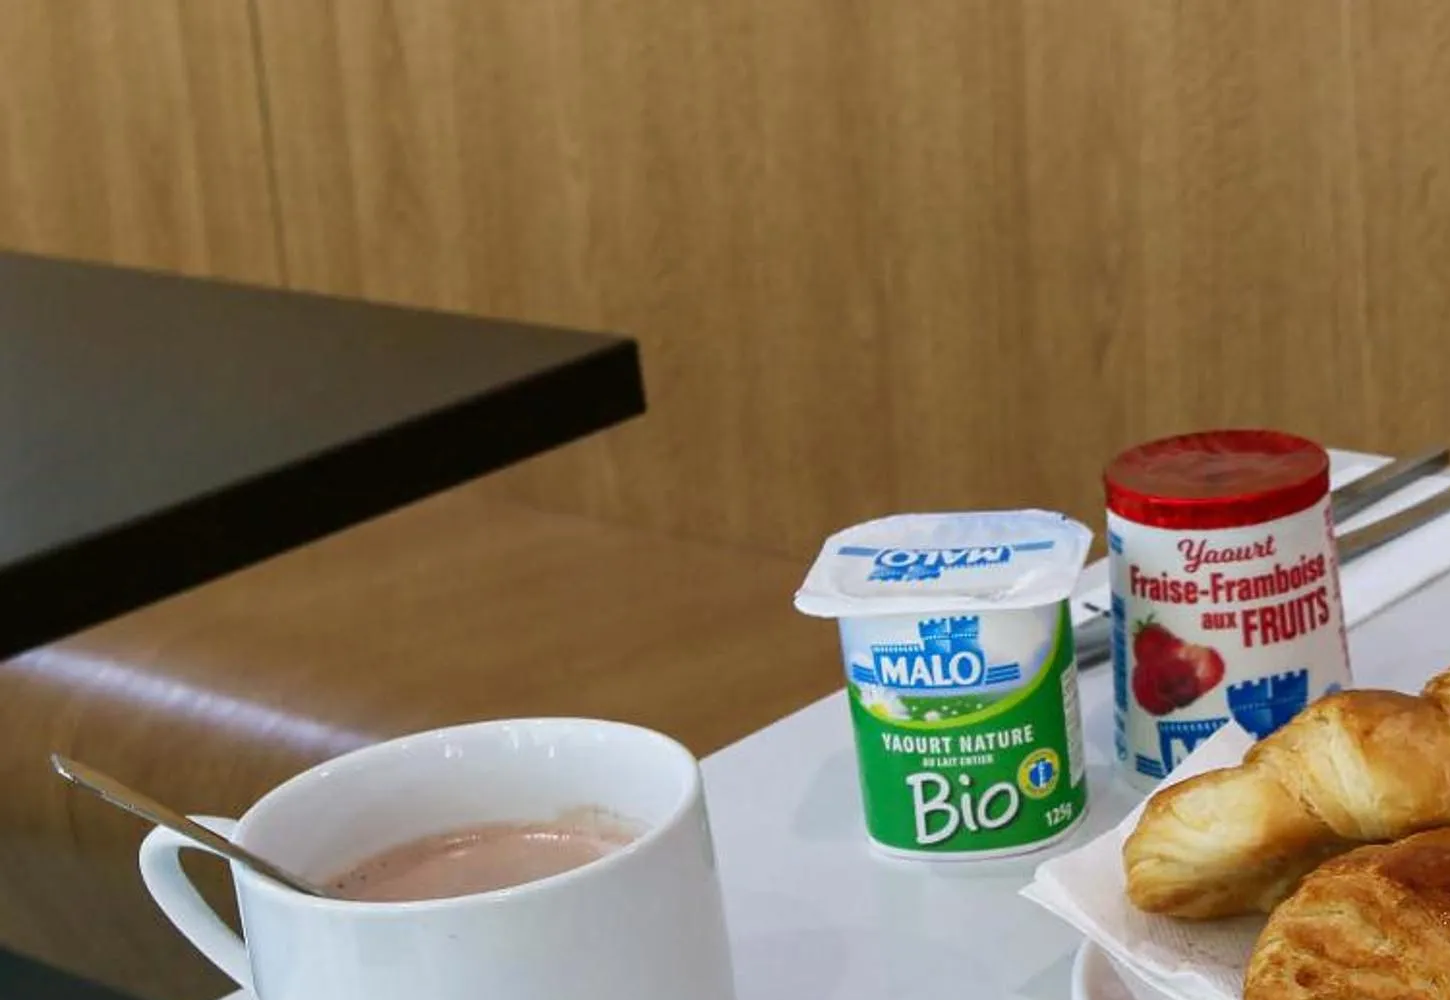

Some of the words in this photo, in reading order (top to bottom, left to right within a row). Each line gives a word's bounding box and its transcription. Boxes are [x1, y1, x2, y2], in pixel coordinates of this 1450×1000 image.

[879, 548, 1005, 568] MALO
[1178, 534, 1276, 573] Yaourt
[1130, 553, 1326, 604] Fraise-Framboise
[1202, 611, 1238, 630] aux
[1241, 586, 1330, 648] FRUITS
[879, 651, 981, 686] MALO
[881, 732, 952, 754] YAOURT
[959, 724, 1034, 753] NATURE
[906, 771, 1019, 845] Bio
